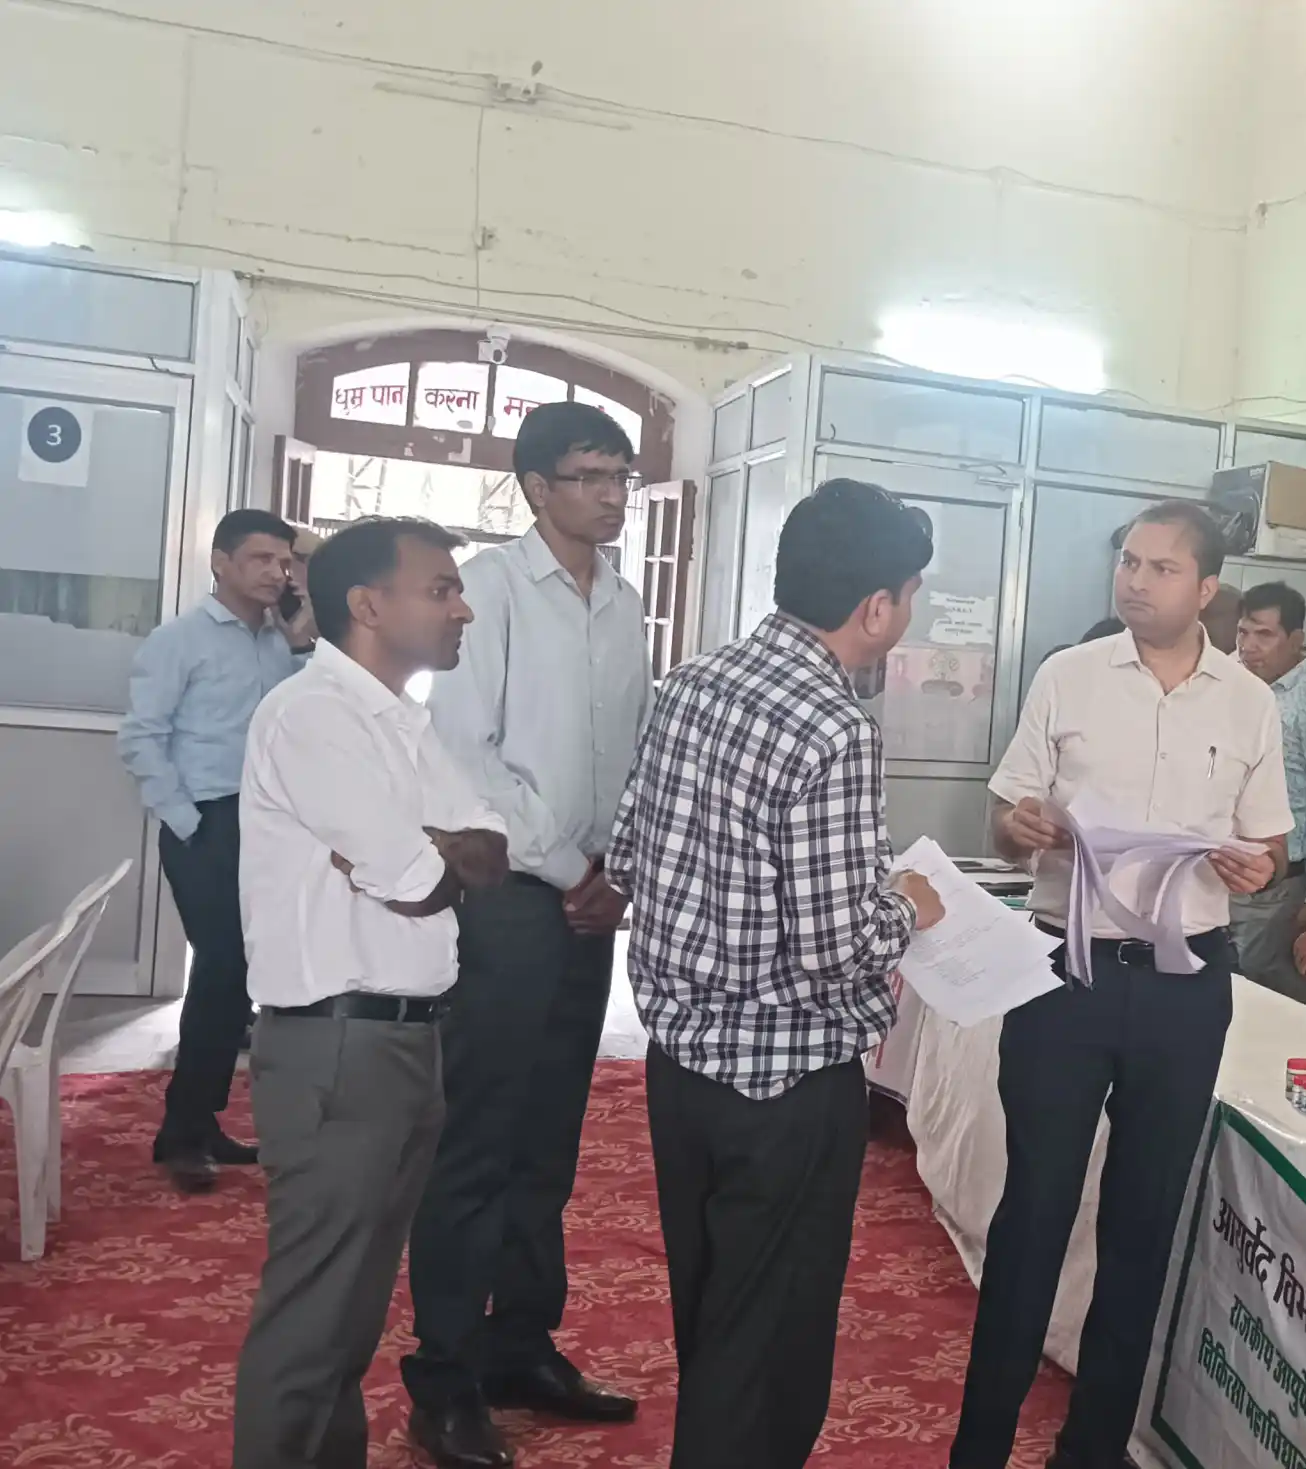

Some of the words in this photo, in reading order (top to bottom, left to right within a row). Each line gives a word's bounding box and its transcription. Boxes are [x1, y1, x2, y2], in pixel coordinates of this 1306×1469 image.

[368, 384, 407, 406] पान
[424, 387, 481, 414] करना
[46, 424, 62, 446] 3
[1212, 1197, 1277, 1292] आयुर्वेद
